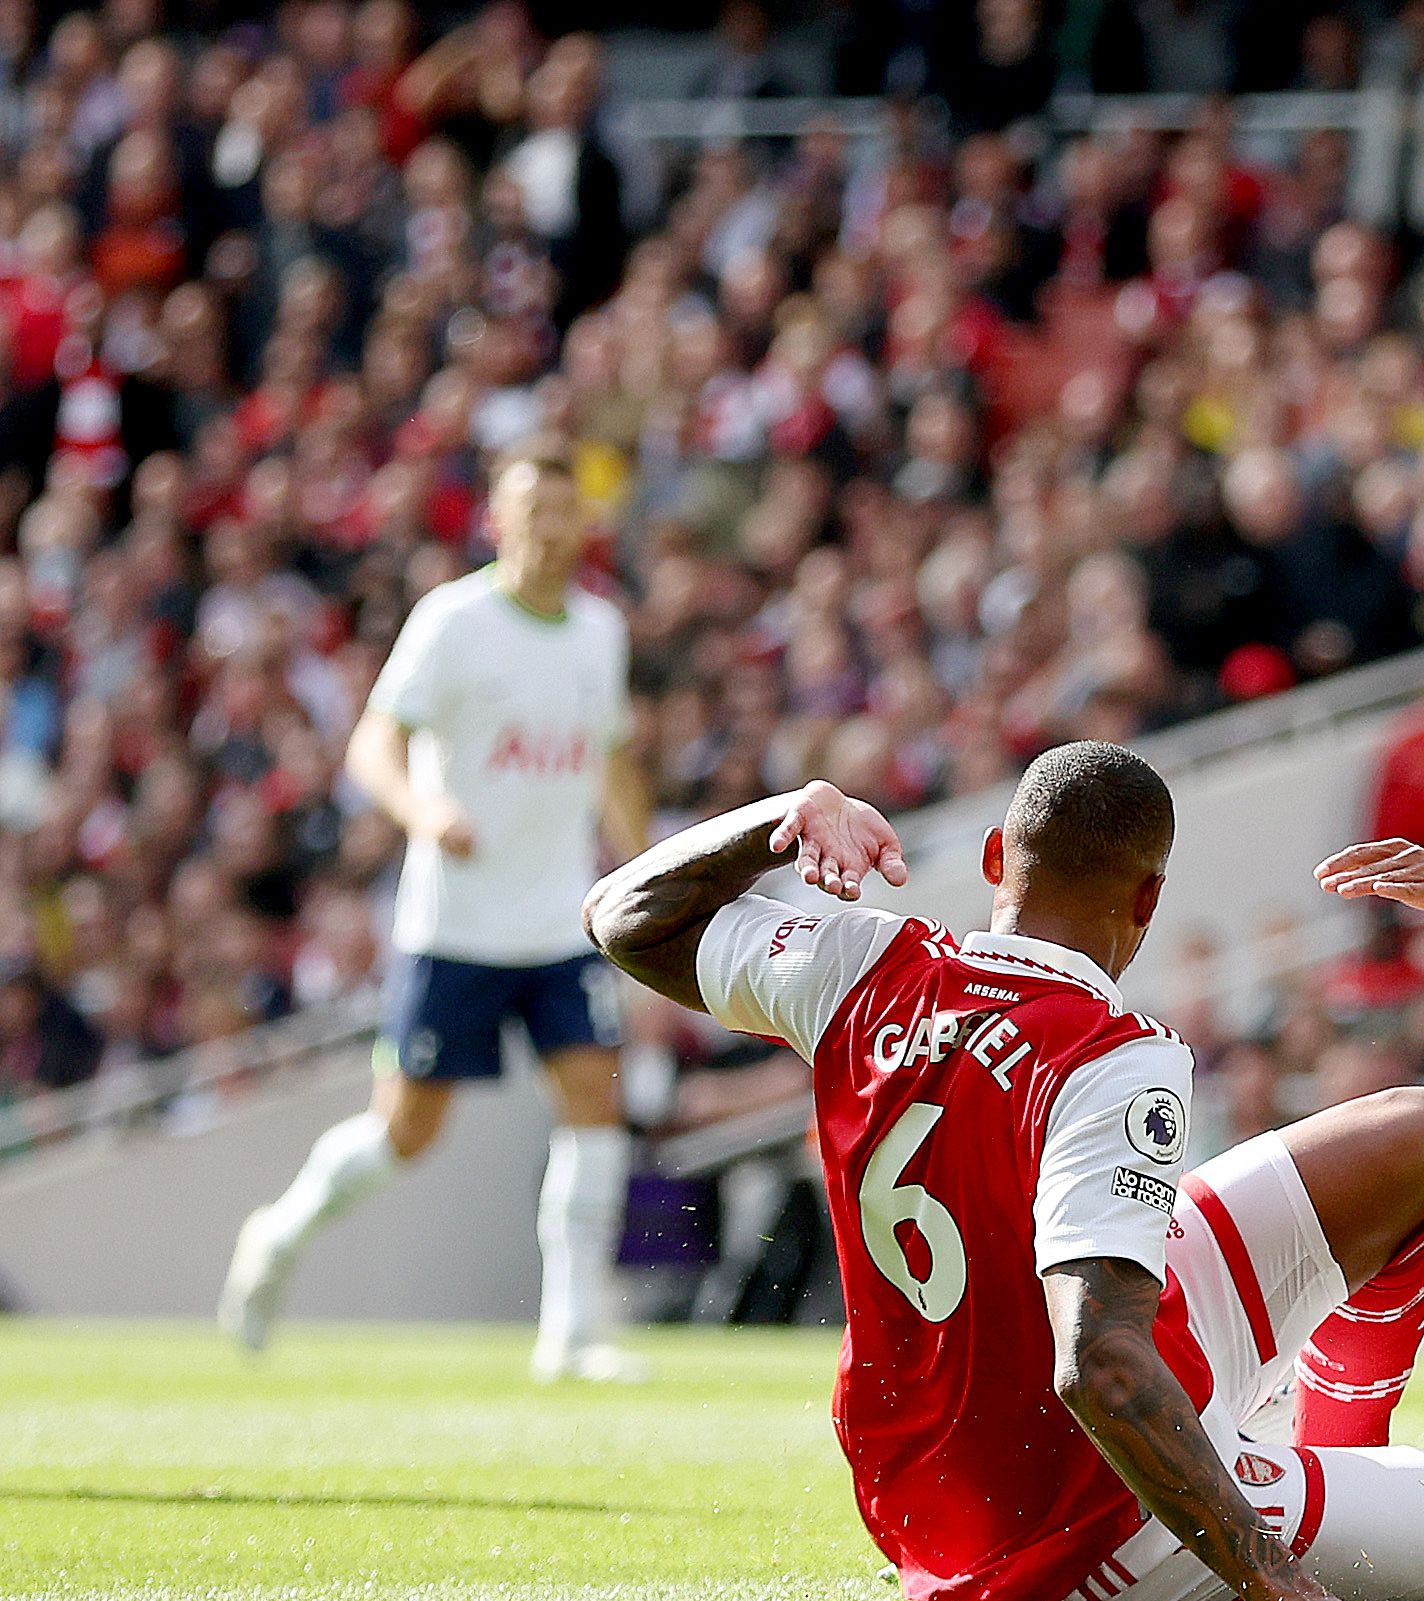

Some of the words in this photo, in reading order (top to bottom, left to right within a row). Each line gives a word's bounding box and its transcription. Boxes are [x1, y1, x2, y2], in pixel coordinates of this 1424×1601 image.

[963, 982, 1021, 1002] ARSENAL
[1112, 1181, 1137, 1197] for
[1114, 1167, 1138, 1186] No
[1139, 1176, 1175, 1204] room
[859, 1102, 967, 1323] 6
